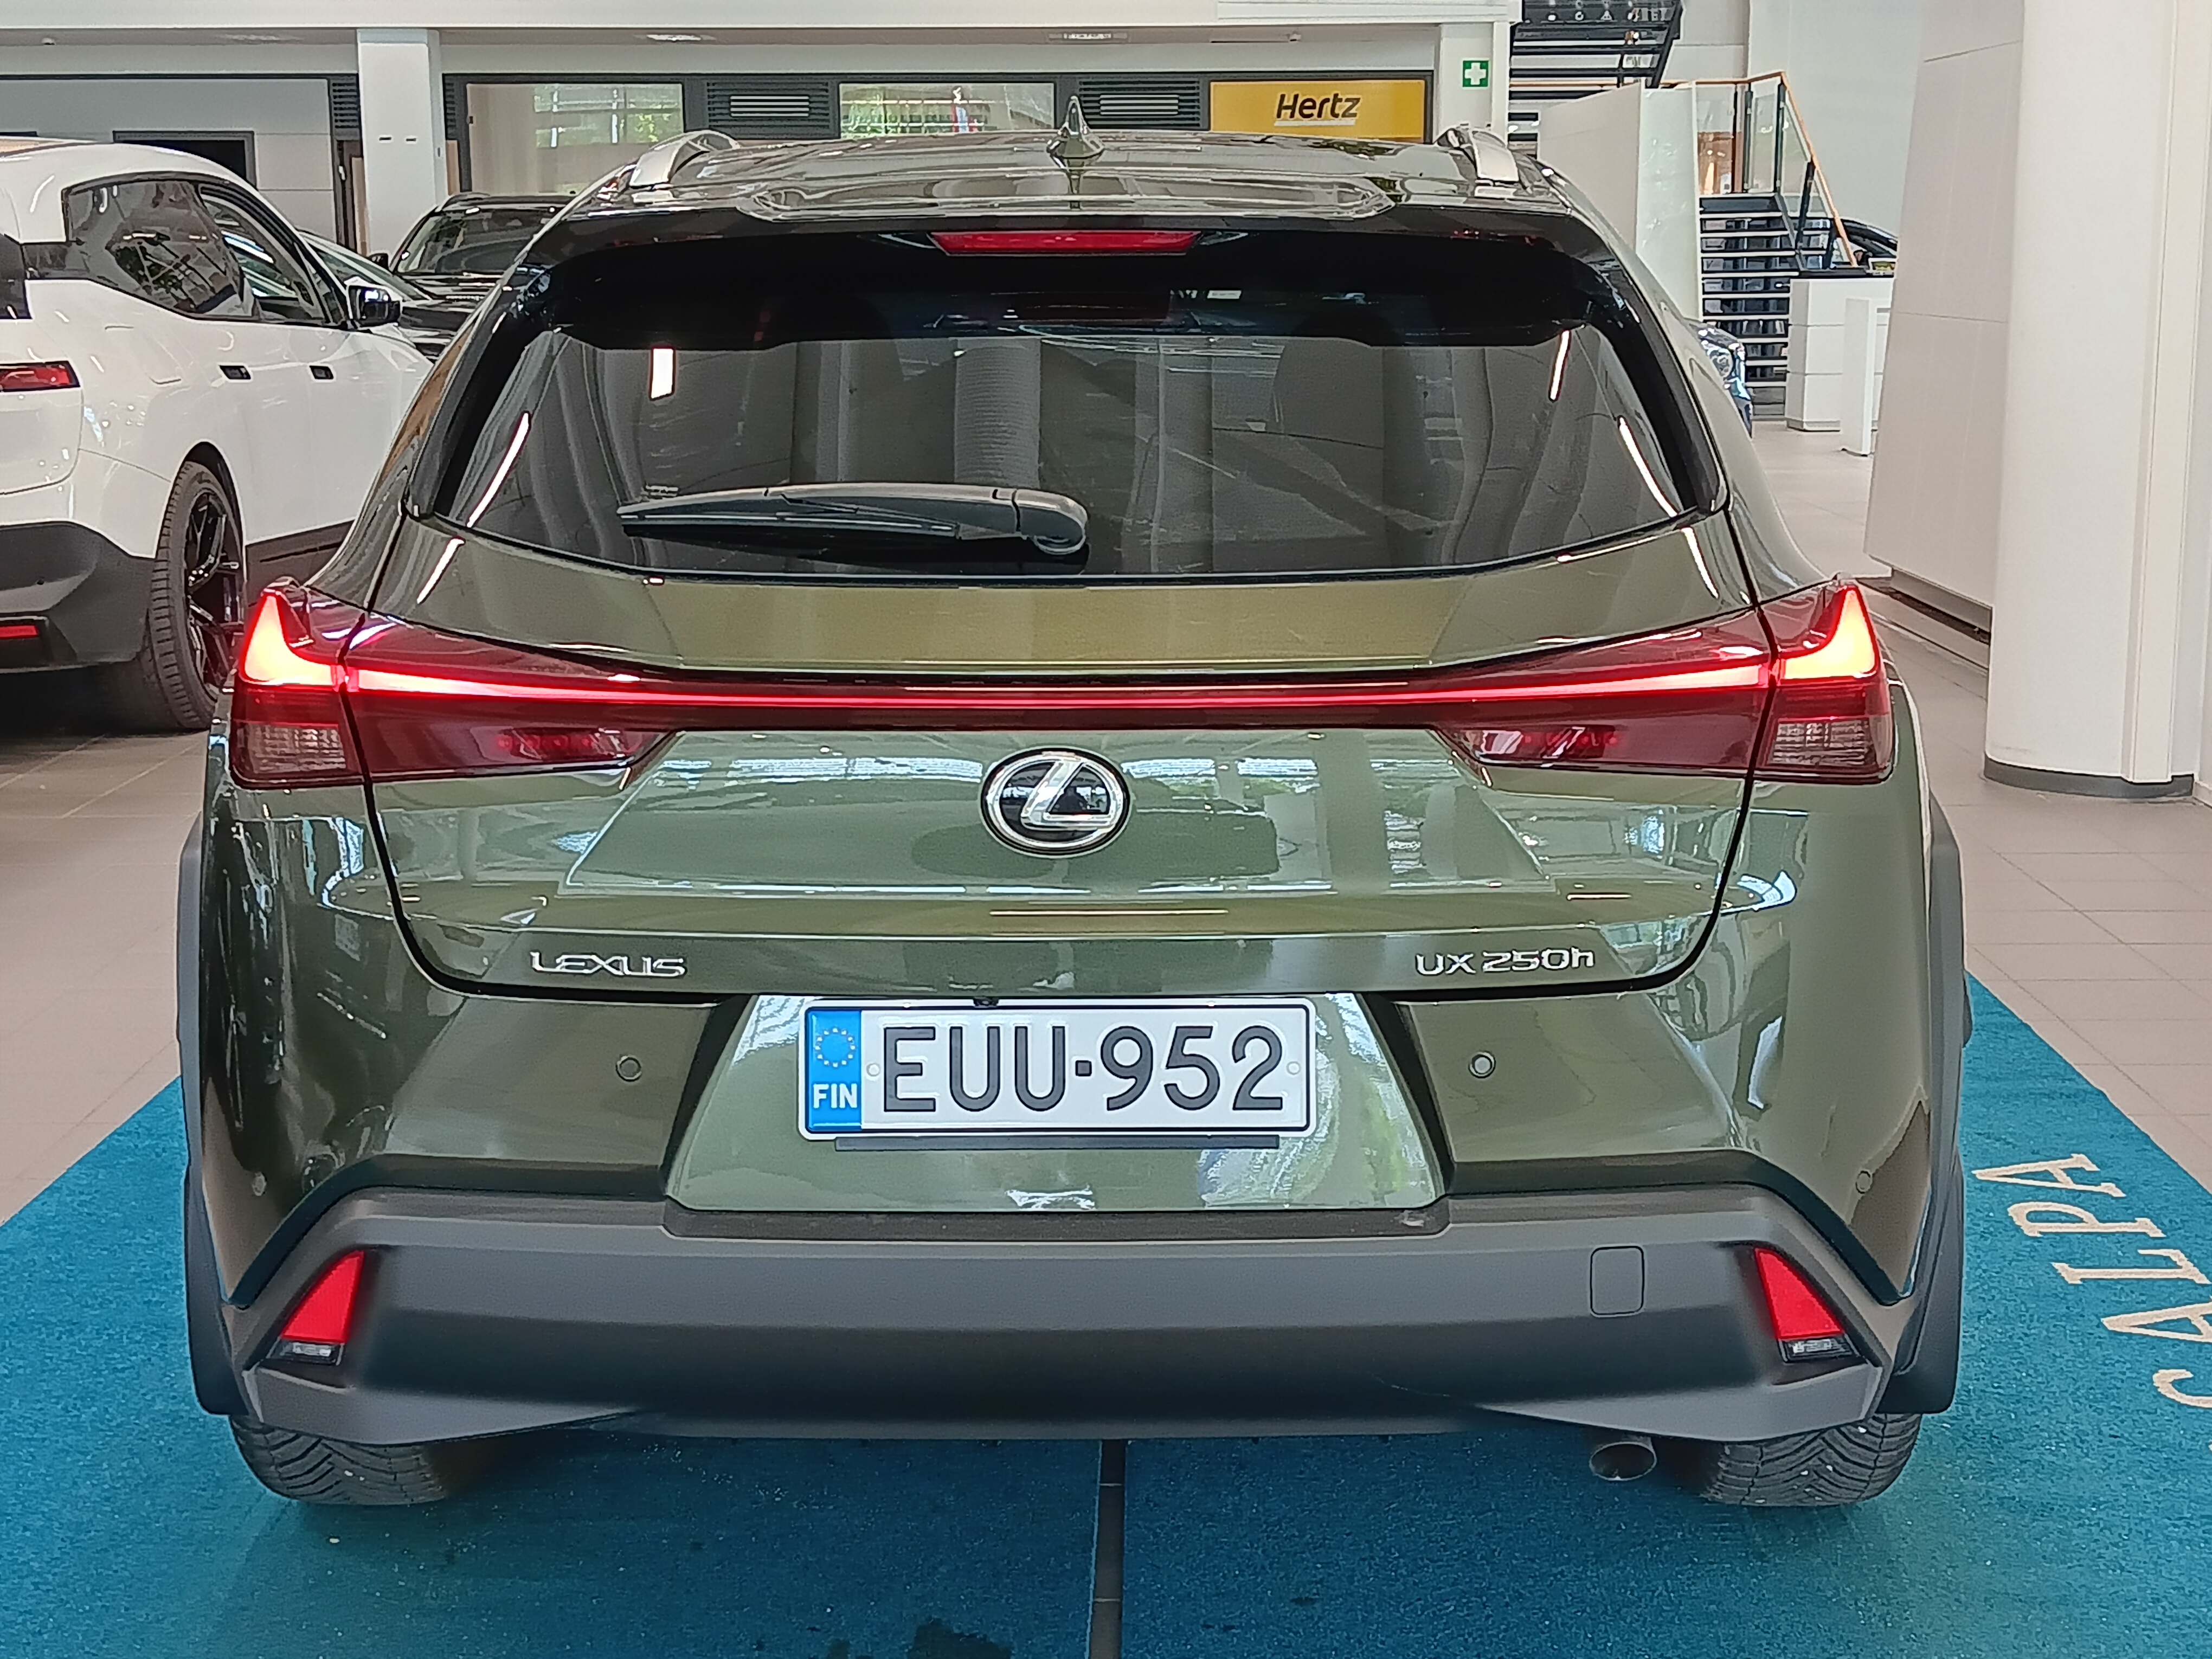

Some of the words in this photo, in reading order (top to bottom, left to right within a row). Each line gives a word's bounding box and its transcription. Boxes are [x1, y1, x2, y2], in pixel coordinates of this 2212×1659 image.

[1276, 93, 1361, 119] Hertz
[530, 951, 687, 978] LEXUS
[1416, 953, 1476, 975] UX
[1482, 946, 1594, 973] 250h
[813, 1083, 858, 1109] FIN
